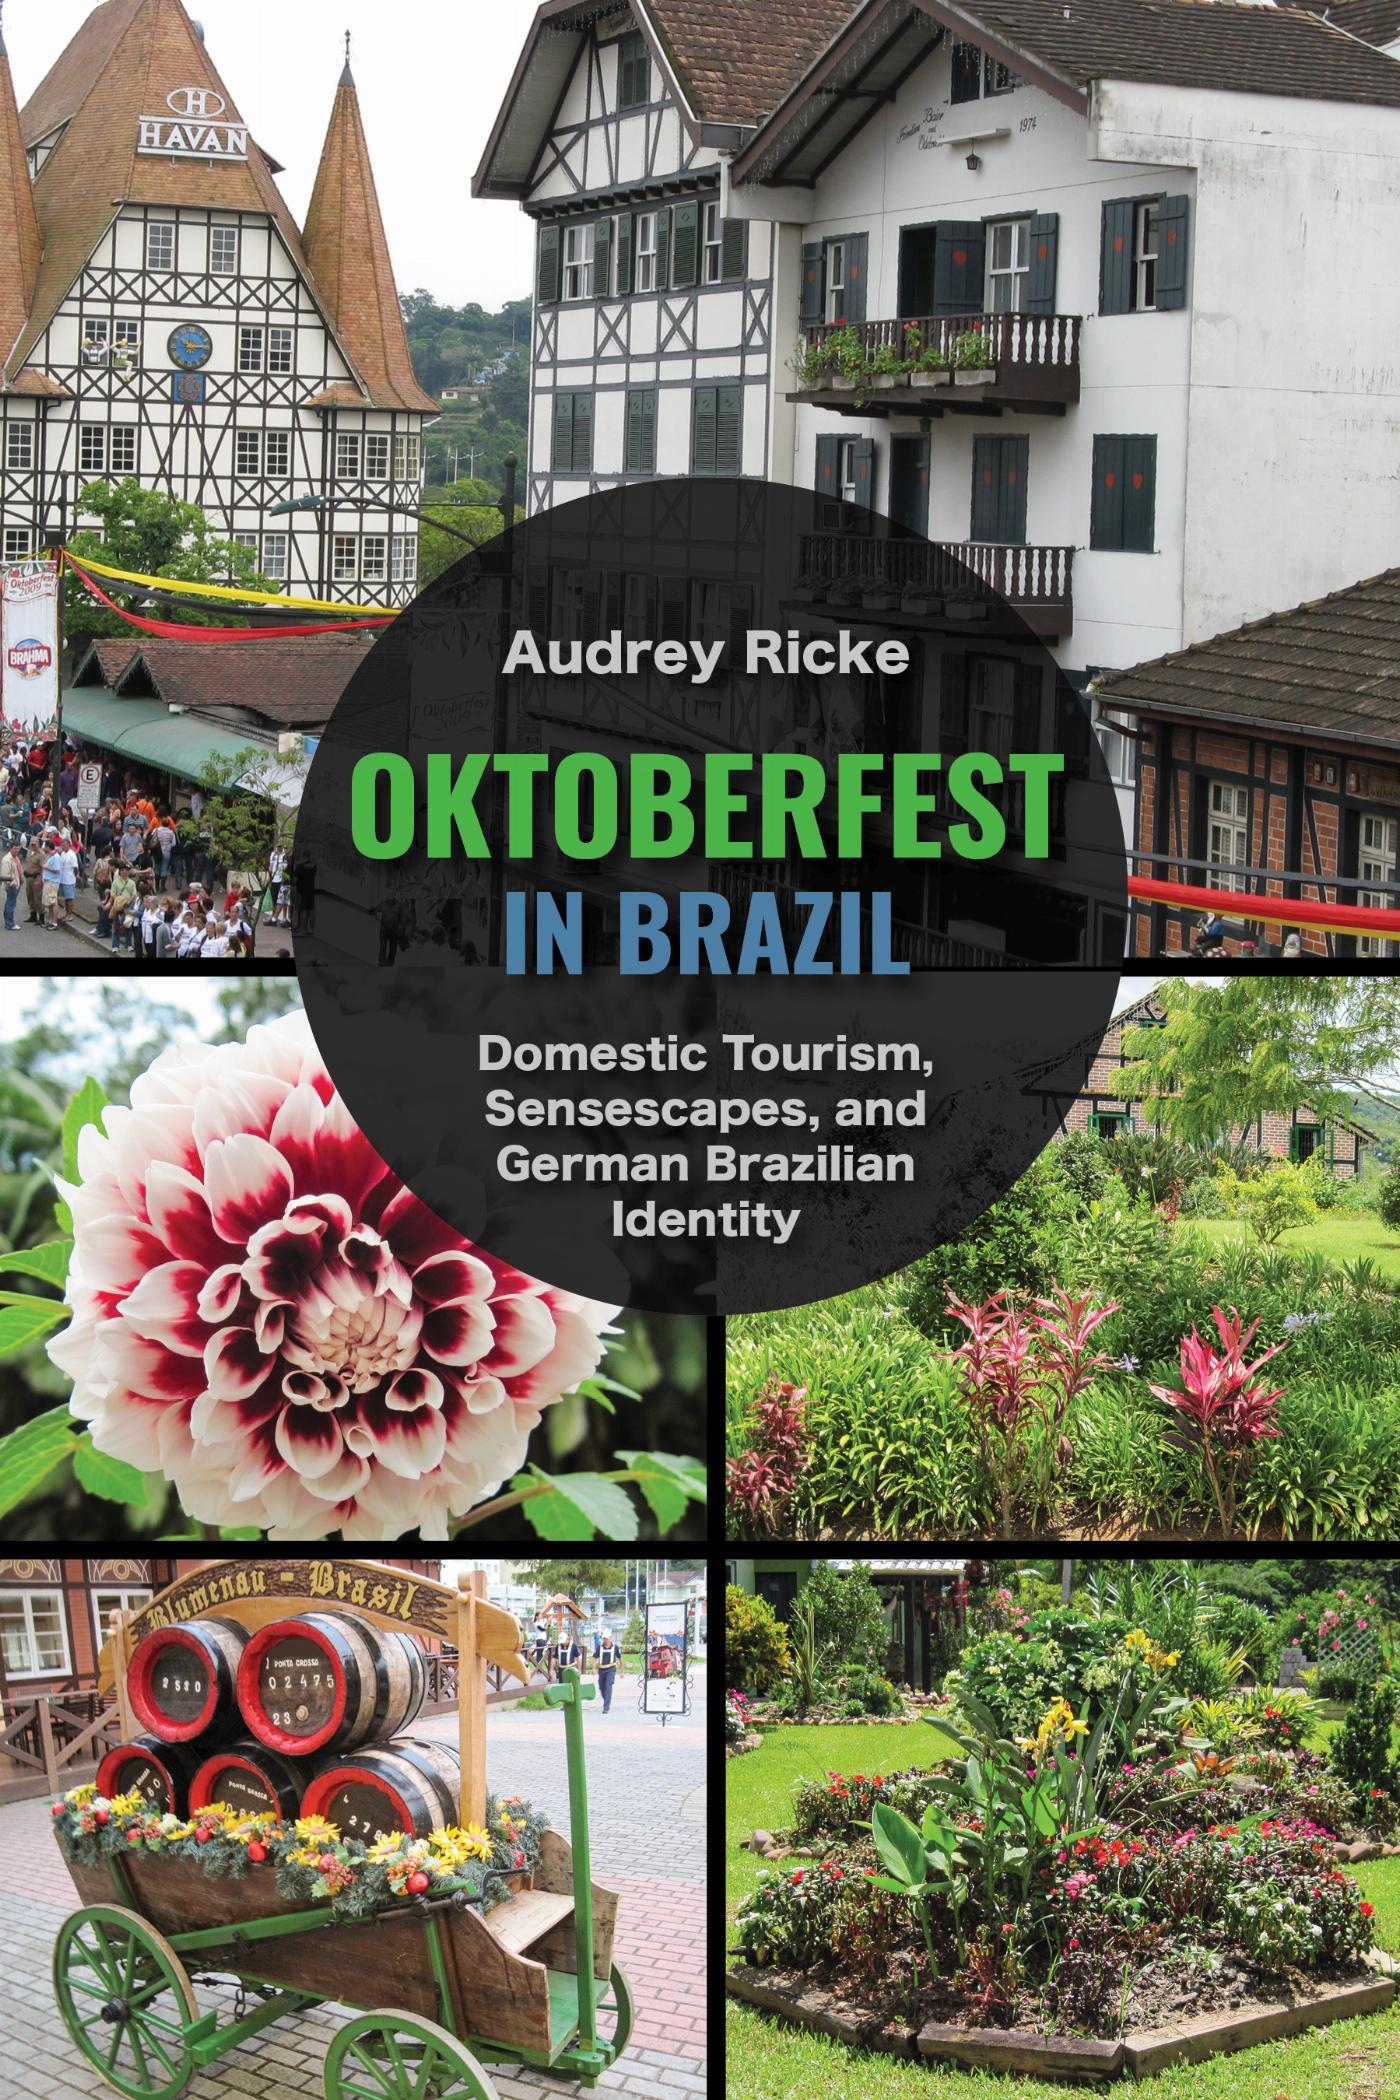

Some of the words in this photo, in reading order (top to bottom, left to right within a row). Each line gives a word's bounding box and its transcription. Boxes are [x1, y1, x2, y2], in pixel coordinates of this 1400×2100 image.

[184, 90, 208, 115] H
[1019, 117, 1037, 133] 1974
[138, 122, 248, 154] HAVAN
[11, 574, 54, 591] Oktoberfest
[10, 649, 49, 665] BRAHMA
[86, 769, 94, 780] E
[147, 1570, 267, 1632] Blumenau
[309, 1561, 419, 1620] Brasil
[274, 1659, 294, 1668] PONTA
